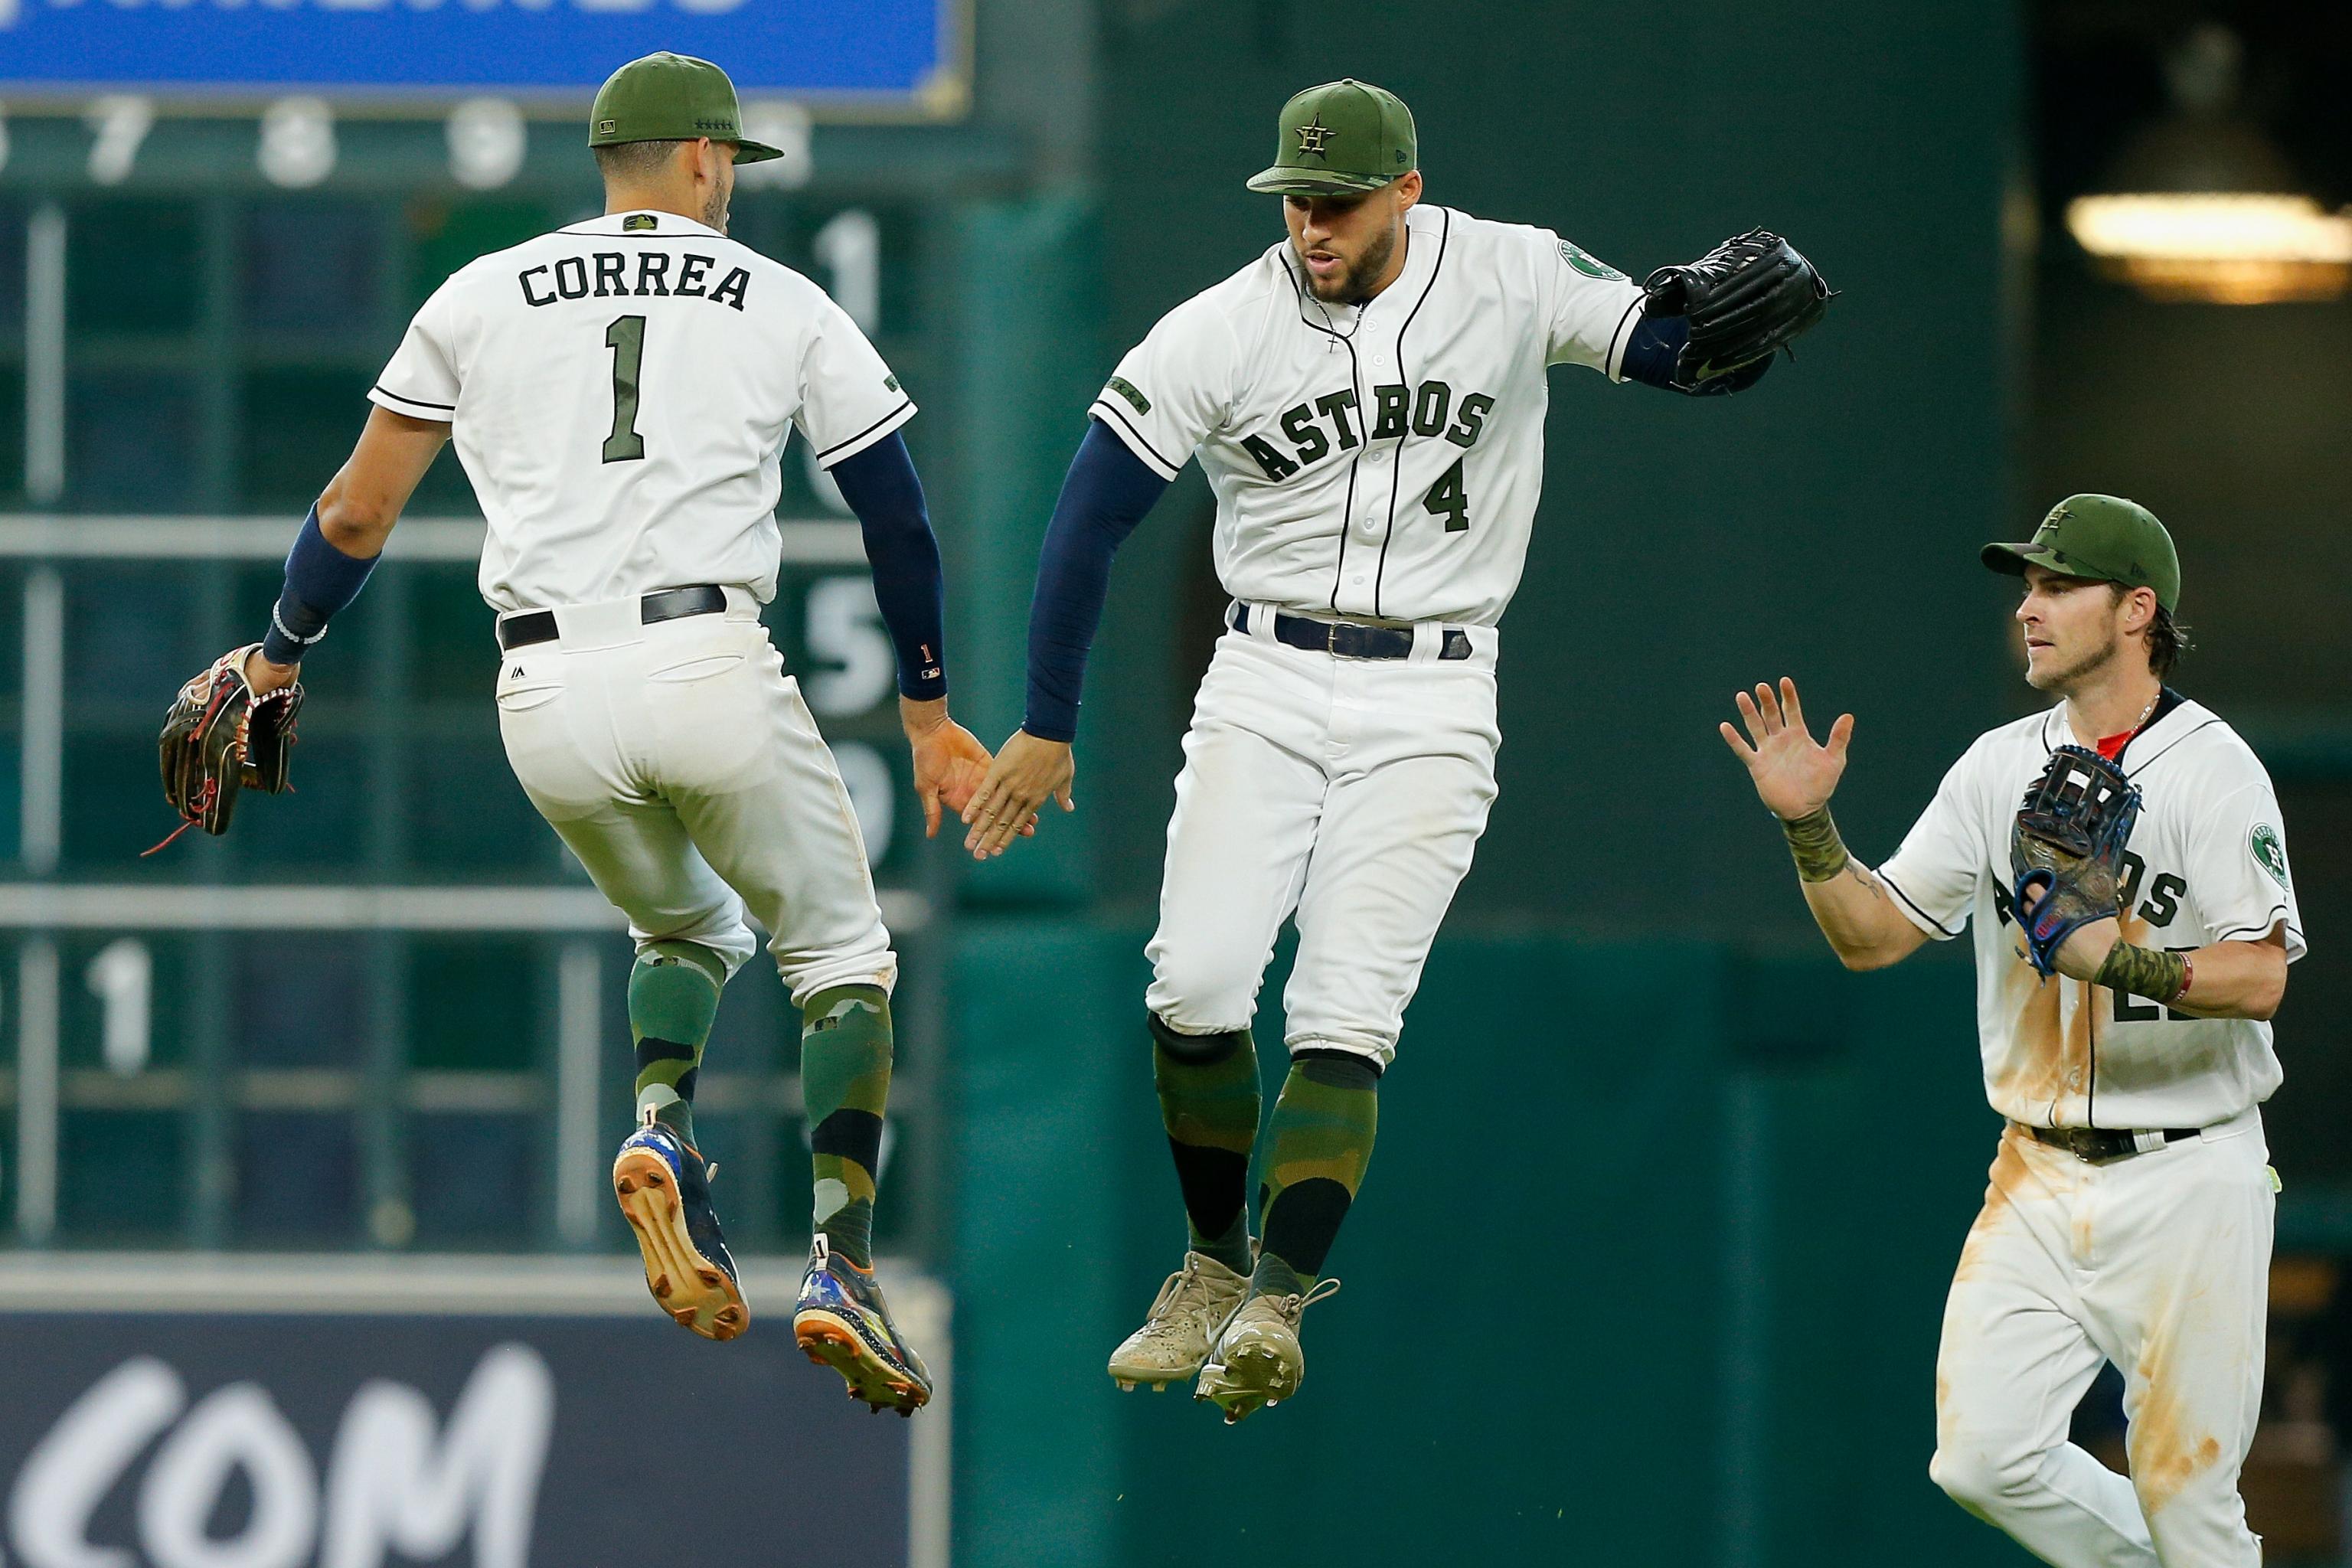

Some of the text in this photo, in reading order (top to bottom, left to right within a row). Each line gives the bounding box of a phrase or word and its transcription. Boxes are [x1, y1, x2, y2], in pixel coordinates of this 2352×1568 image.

[83, 93, 154, 186] 7
[257, 95, 336, 189] 8
[518, 251, 751, 312] CORREA
[815, 207, 880, 338] 1
[601, 314, 647, 465] 1
[1240, 380, 1495, 483] ASTROS
[1422, 456, 1469, 533] 4
[805, 577, 894, 719] 5
[920, 642, 933, 663] 1
[84, 937, 152, 1076] 1
[816, 1240, 825, 1259] 1
